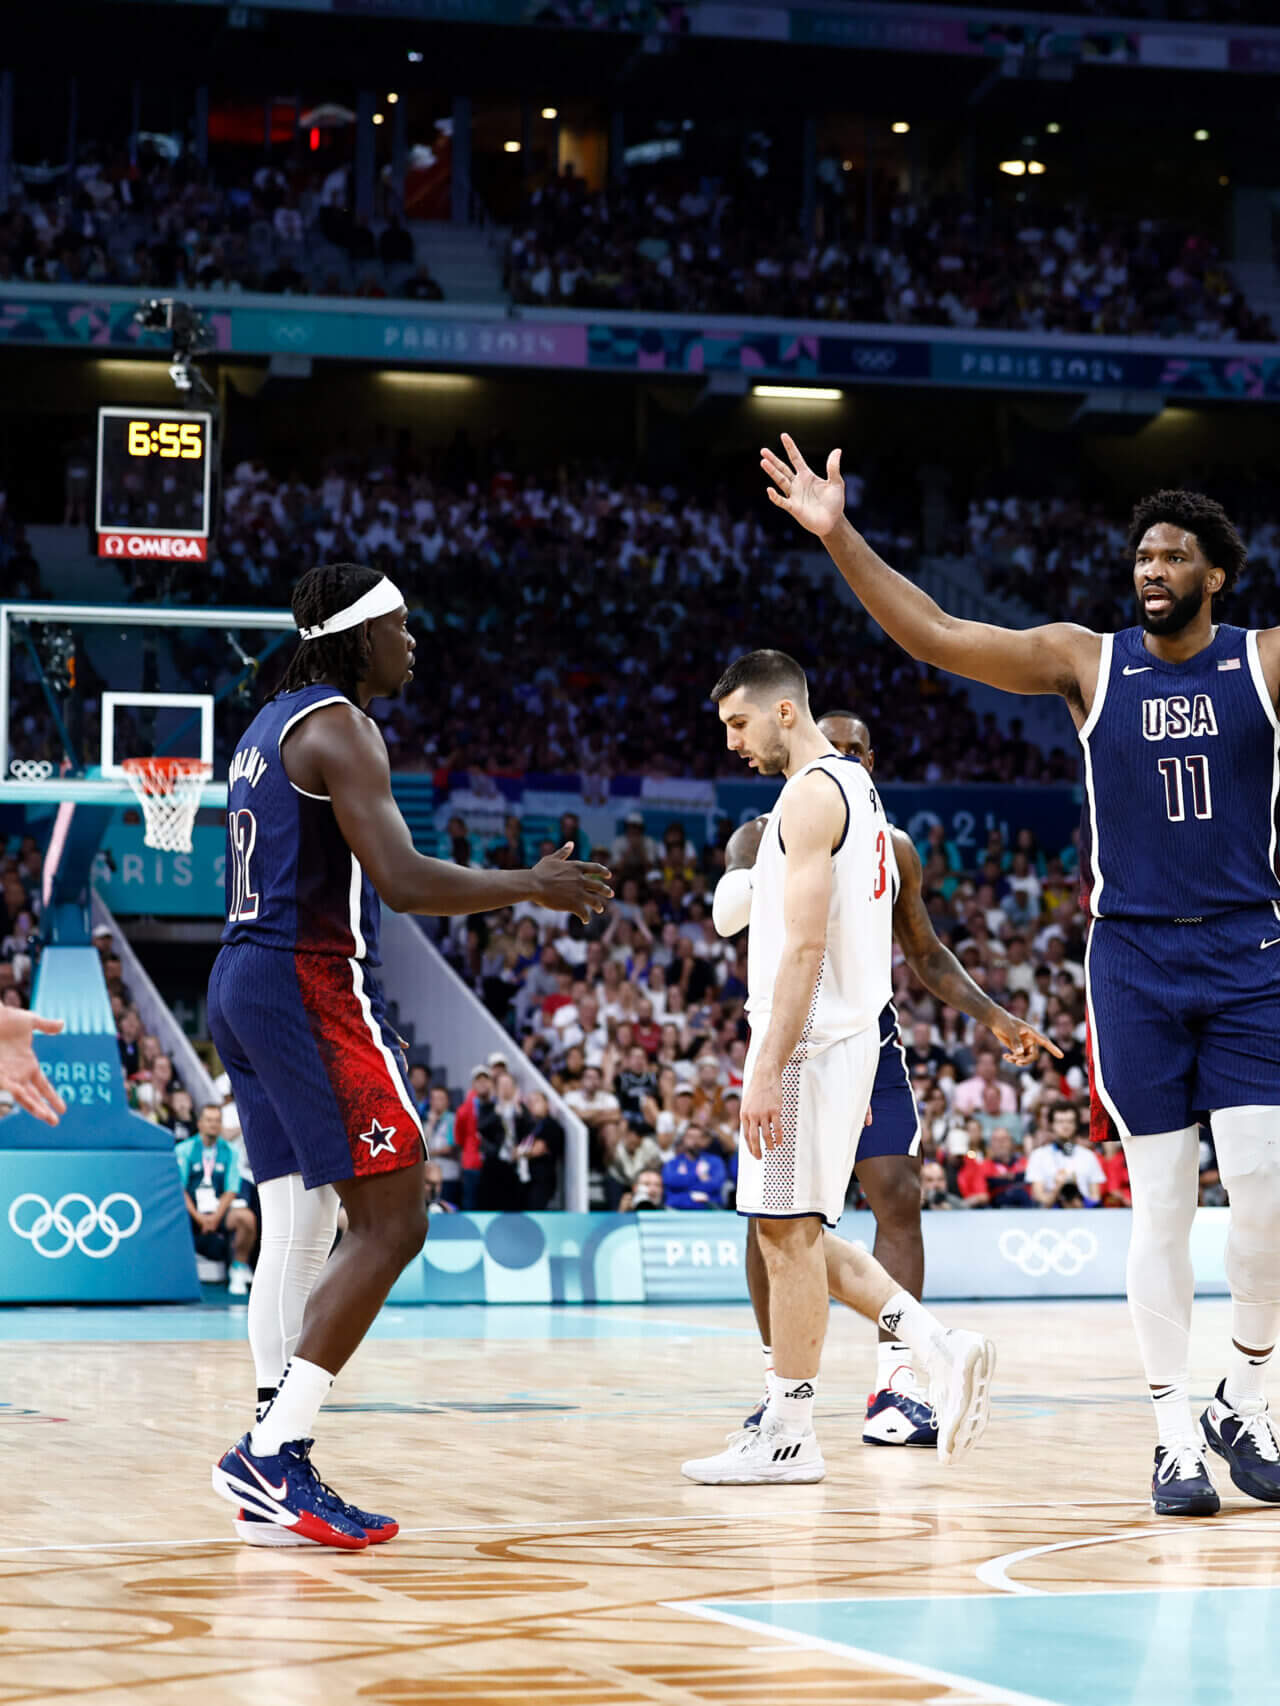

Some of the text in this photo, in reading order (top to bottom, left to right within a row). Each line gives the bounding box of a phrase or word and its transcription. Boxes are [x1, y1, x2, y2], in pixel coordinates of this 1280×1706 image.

[961, 352, 1041, 379] PARIS
[129, 421, 202, 459] 6:55
[127, 536, 202, 558] OMEGA
[1143, 694, 1219, 741] USA
[1158, 755, 1212, 822] 11
[90, 852, 193, 886] ARIS
[229, 809, 259, 922] 12
[40, 1062, 111, 1083] PARIS
[57, 1084, 111, 1104] 024
[665, 1240, 738, 1267] PAR
